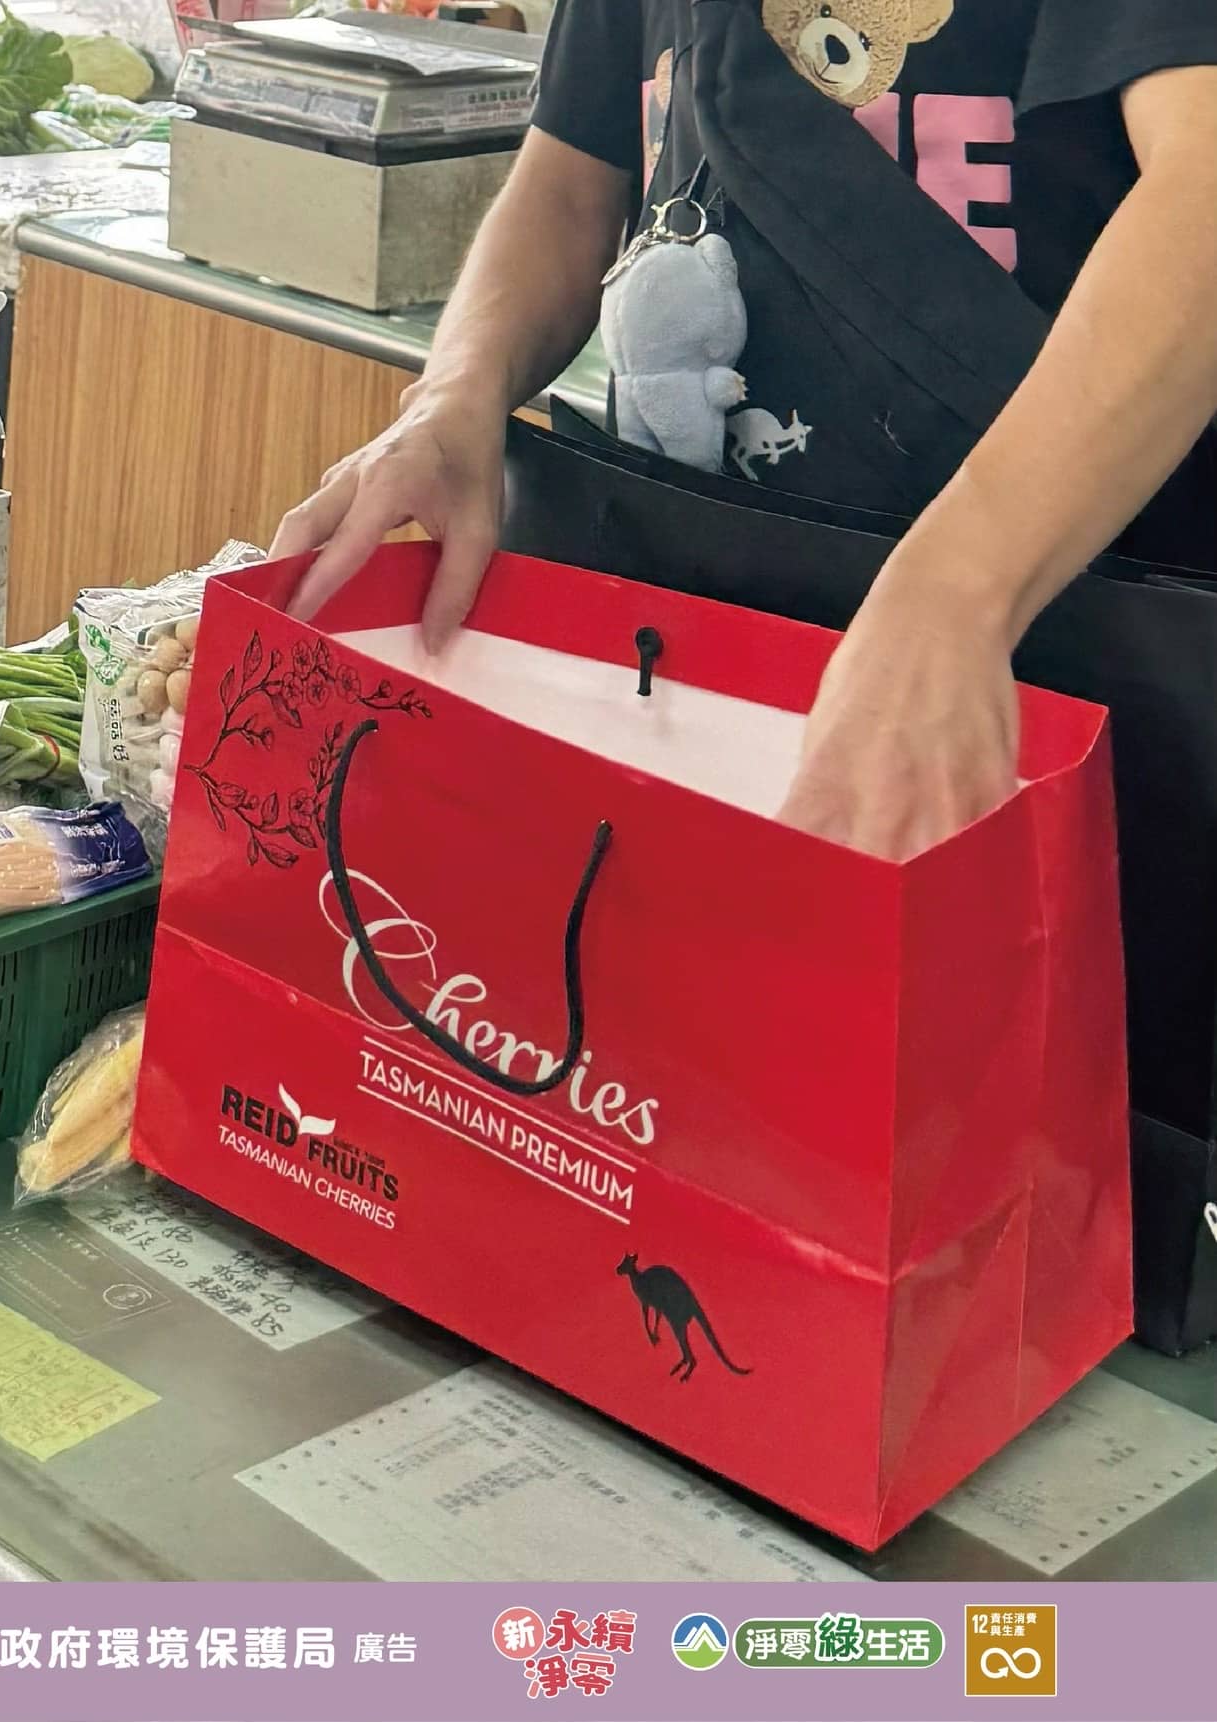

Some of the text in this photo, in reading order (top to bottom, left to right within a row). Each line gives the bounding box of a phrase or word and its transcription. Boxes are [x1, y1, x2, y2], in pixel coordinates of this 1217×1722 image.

[319, 867, 659, 1145] Cherries
[221, 1084, 299, 1147] REID
[307, 1136, 399, 1201] FRUITS
[359, 1050, 633, 1210] TASMANIAN PREMIUM
[218, 1124, 312, 1190] TASMANIAN
[314, 1177, 397, 1230] CHERRIES
